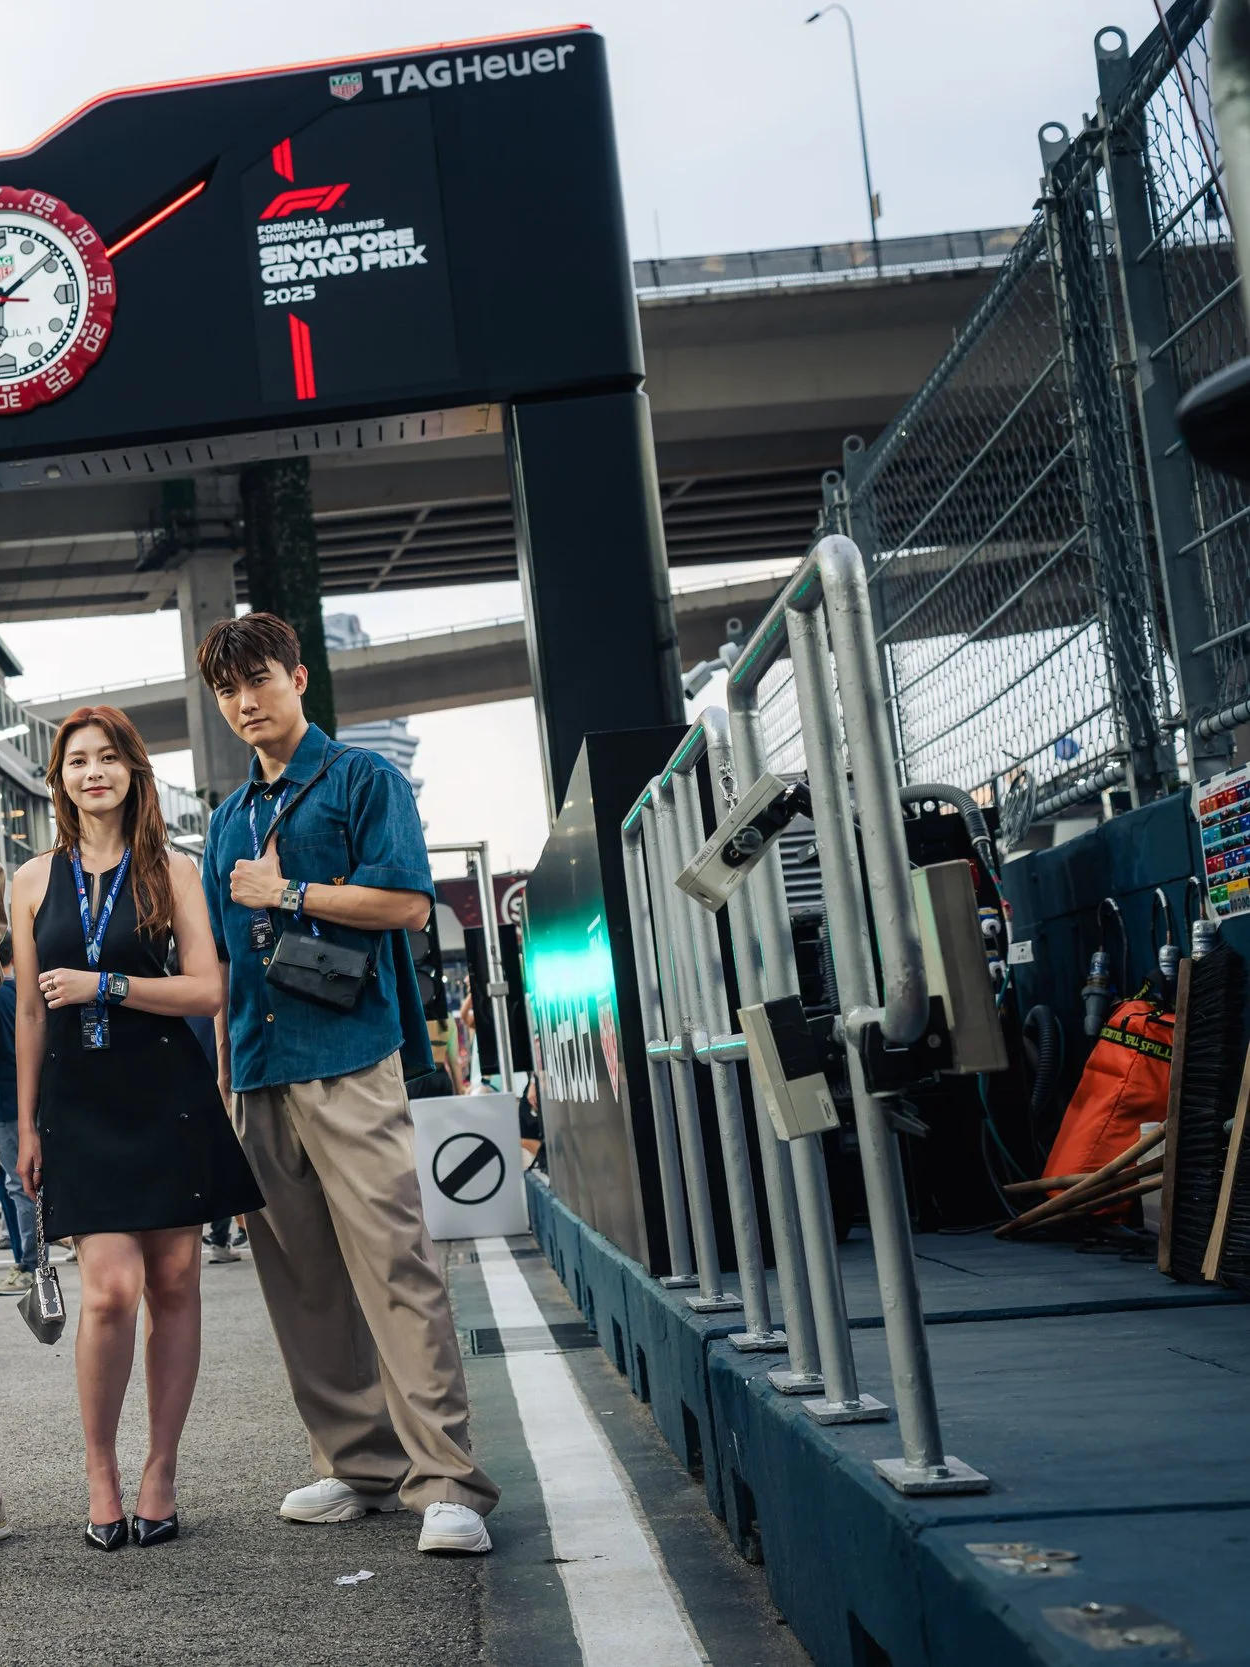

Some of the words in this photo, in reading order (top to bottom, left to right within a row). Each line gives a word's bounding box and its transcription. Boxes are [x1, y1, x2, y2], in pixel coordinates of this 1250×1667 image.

[29, 192, 59, 213] 05
[75, 224, 97, 246] 10
[257, 219, 317, 236] FORMULA
[258, 226, 328, 245] SINGAPORE
[329, 218, 385, 235] AIRLINES
[259, 227, 415, 266] SINGAPORE
[261, 255, 358, 284] GRAND
[361, 245, 428, 272] PRIX
[96, 274, 113, 295] 15
[264, 284, 317, 306] 2025
[83, 323, 106, 353] 20
[45, 367, 74, 394] 25
[1139, 1040, 1173, 1060] SPILL
